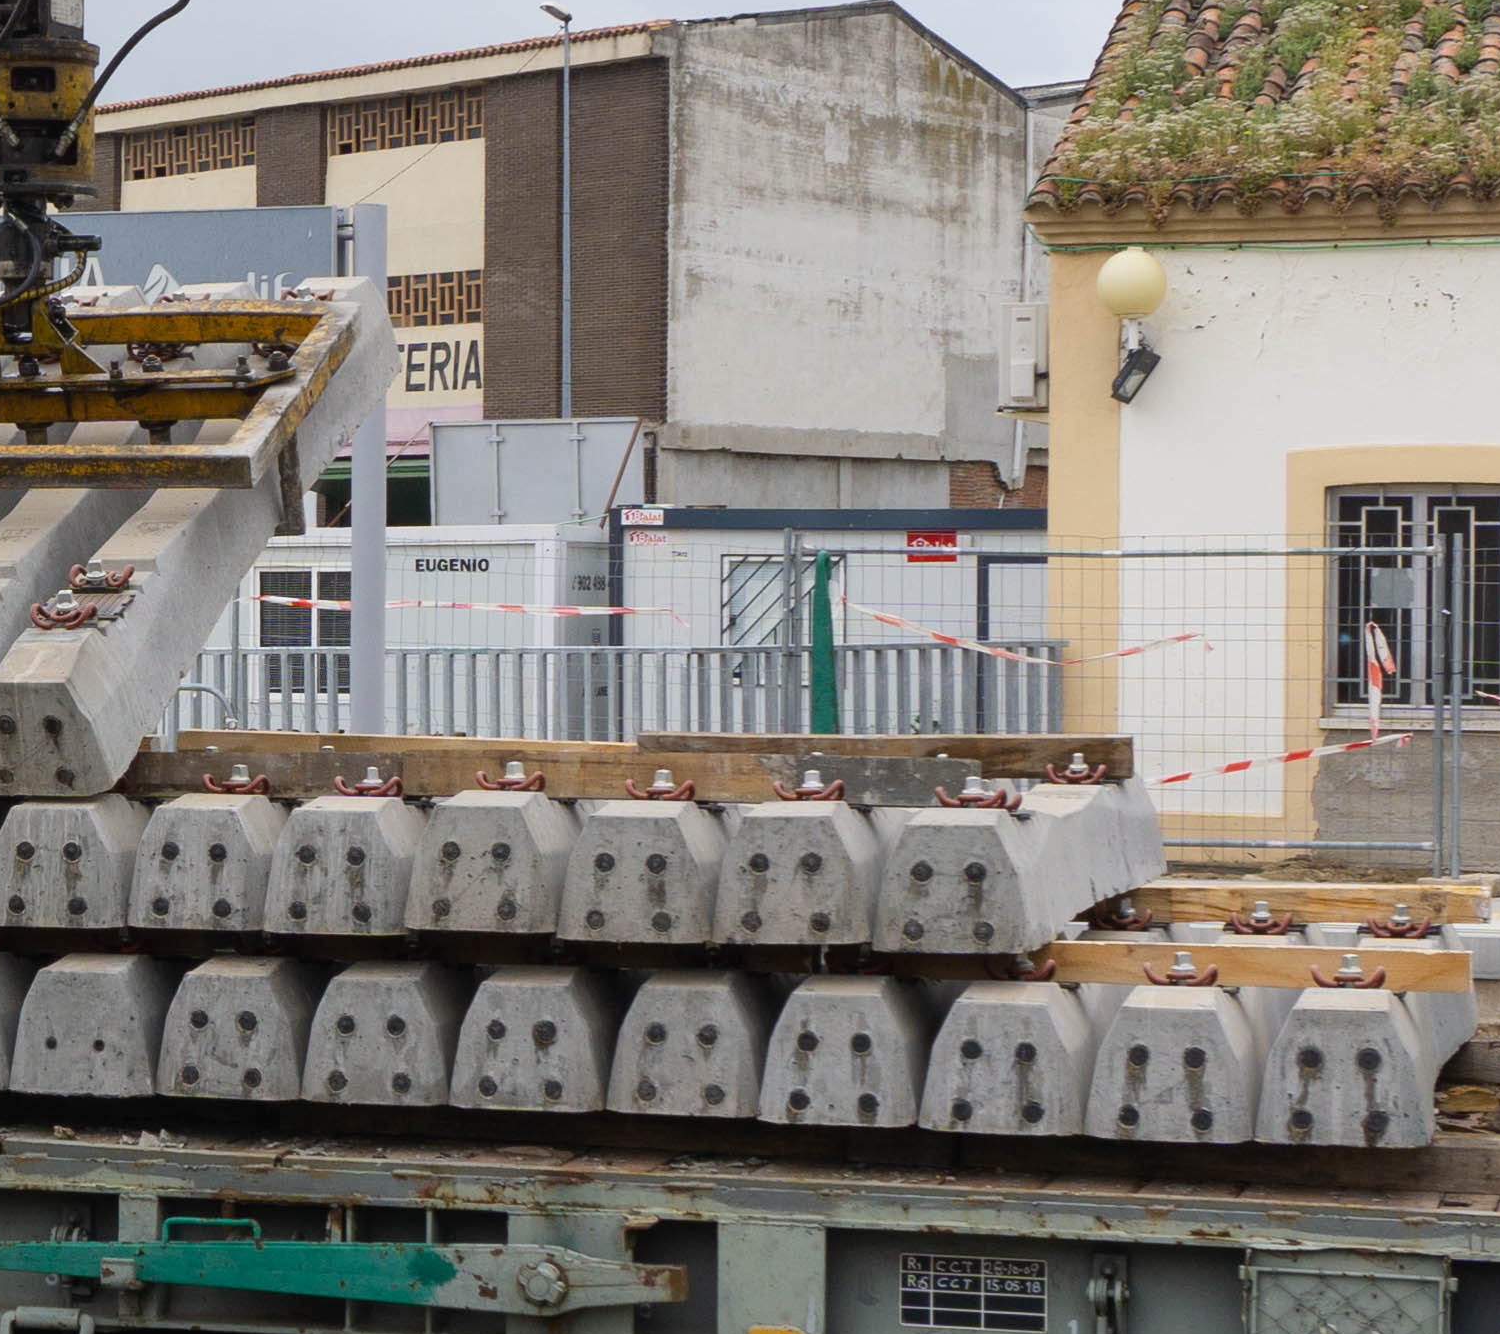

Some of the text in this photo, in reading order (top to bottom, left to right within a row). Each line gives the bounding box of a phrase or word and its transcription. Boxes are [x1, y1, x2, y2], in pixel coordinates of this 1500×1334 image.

[397, 339, 482, 392] ERIA
[415, 558, 490, 573] EUGENIO
[936, 1260, 973, 1274] CCT
[937, 1278, 973, 1291] CCT
